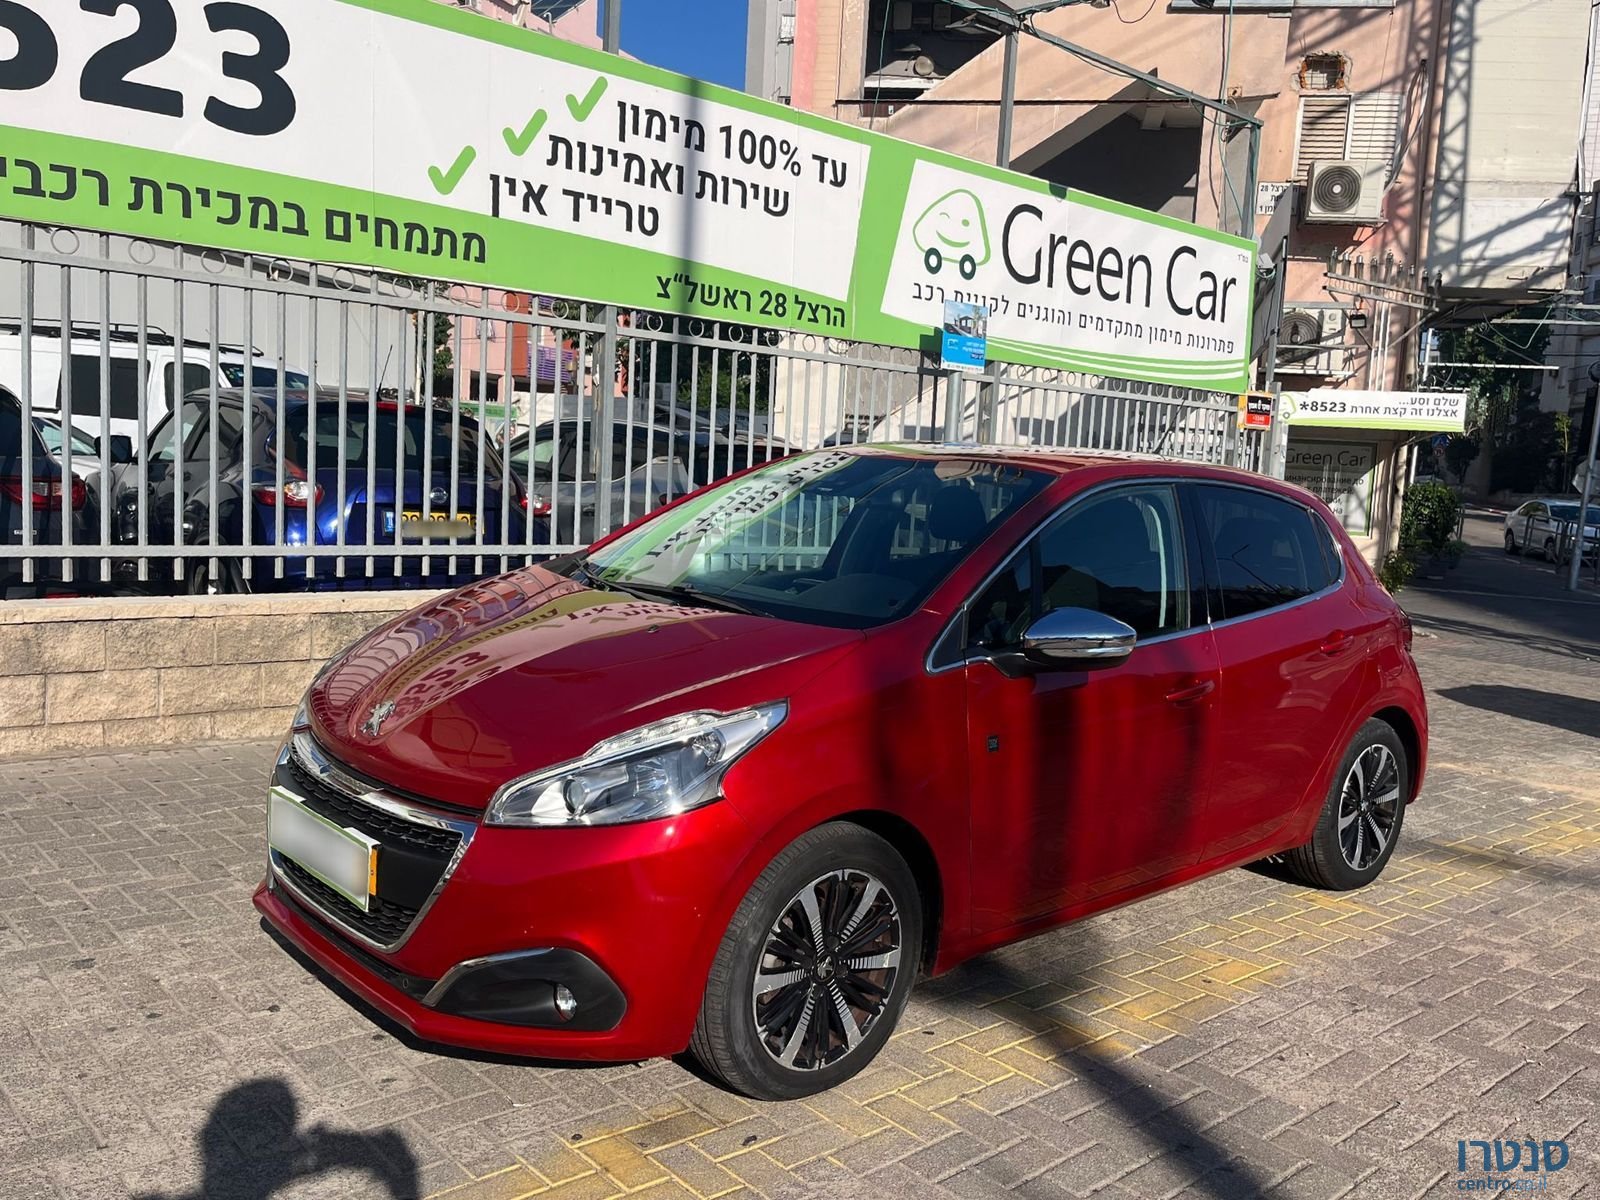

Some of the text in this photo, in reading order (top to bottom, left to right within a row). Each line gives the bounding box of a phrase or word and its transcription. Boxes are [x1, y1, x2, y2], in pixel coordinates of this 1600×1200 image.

[616, 100, 848, 188] עד 100% מימון
[546, 133, 790, 218] שירות ואמינות
[128, 175, 309, 237] במכירת
[489, 173, 660, 237] טרייד אין
[325, 208, 487, 264] מתמחים
[1001, 203, 1237, 323] Green Car
[759, 290, 788, 318] 28
[912, 282, 945, 304] רכב
[794, 294, 847, 329] הרצל
[1017, 302, 1072, 326] והוגנים
[1078, 313, 1143, 339] מתקדמים
[1149, 326, 1182, 345] מימון
[1186, 333, 1235, 354] פתרונות
[1350, 405, 1458, 418] אצלנו זה קצת אחרת
[1433, 396, 1459, 407] שלם
[1285, 448, 1367, 467] Green Car
[1284, 473, 1352, 485] инансирование
